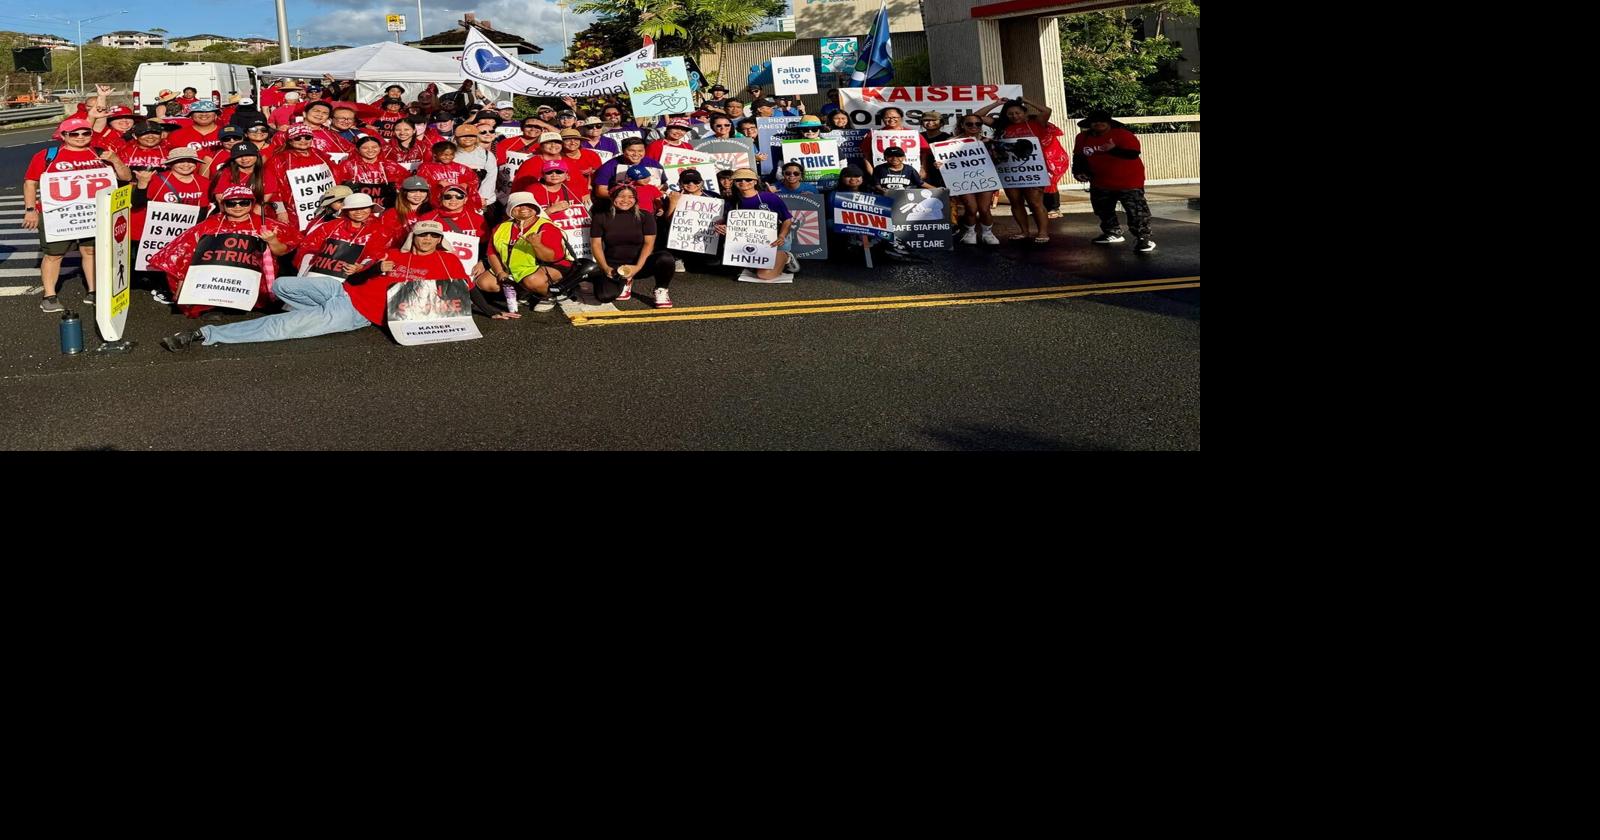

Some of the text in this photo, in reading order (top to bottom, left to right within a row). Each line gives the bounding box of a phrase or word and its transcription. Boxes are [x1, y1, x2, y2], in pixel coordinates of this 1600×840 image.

[635, 61, 660, 69] HONK
[777, 66, 811, 74] Failure
[861, 84, 1001, 103] KAISER
[799, 142, 821, 155] ON
[876, 138, 916, 154] UP
[938, 147, 985, 161] HAWAII
[944, 157, 987, 170] IS NOT
[963, 169, 985, 179] FOR
[997, 164, 1044, 174] SECOND
[49, 172, 109, 181] STAND
[1003, 174, 1041, 183] CLASS
[49, 178, 112, 202] UP
[952, 177, 998, 193] SCABS
[115, 188, 129, 200] STATE
[300, 186, 314, 197] IS
[361, 186, 381, 197] ON
[853, 193, 877, 205] FAIR
[564, 207, 583, 217] ON
[841, 201, 884, 215] CONTRACT
[151, 211, 195, 225] HAWAII
[675, 210, 713, 219] IF YOU
[730, 211, 775, 221] EVEN OUR
[672, 218, 694, 226] LOVE
[841, 210, 887, 230] NOW
[114, 223, 127, 236] STOP
[150, 225, 163, 235] IS
[672, 225, 693, 233] MOM
[892, 223, 950, 232] SAFE STAFFING
[734, 232, 768, 241] DESERVE
[142, 240, 169, 250] SEC
[224, 237, 249, 251] ON
[923, 240, 945, 248] CARE
[730, 253, 770, 265] HNHP
[211, 277, 242, 286] KAISER
[195, 283, 251, 296] PERMANENTE
[406, 327, 467, 336] PERMANENTE
